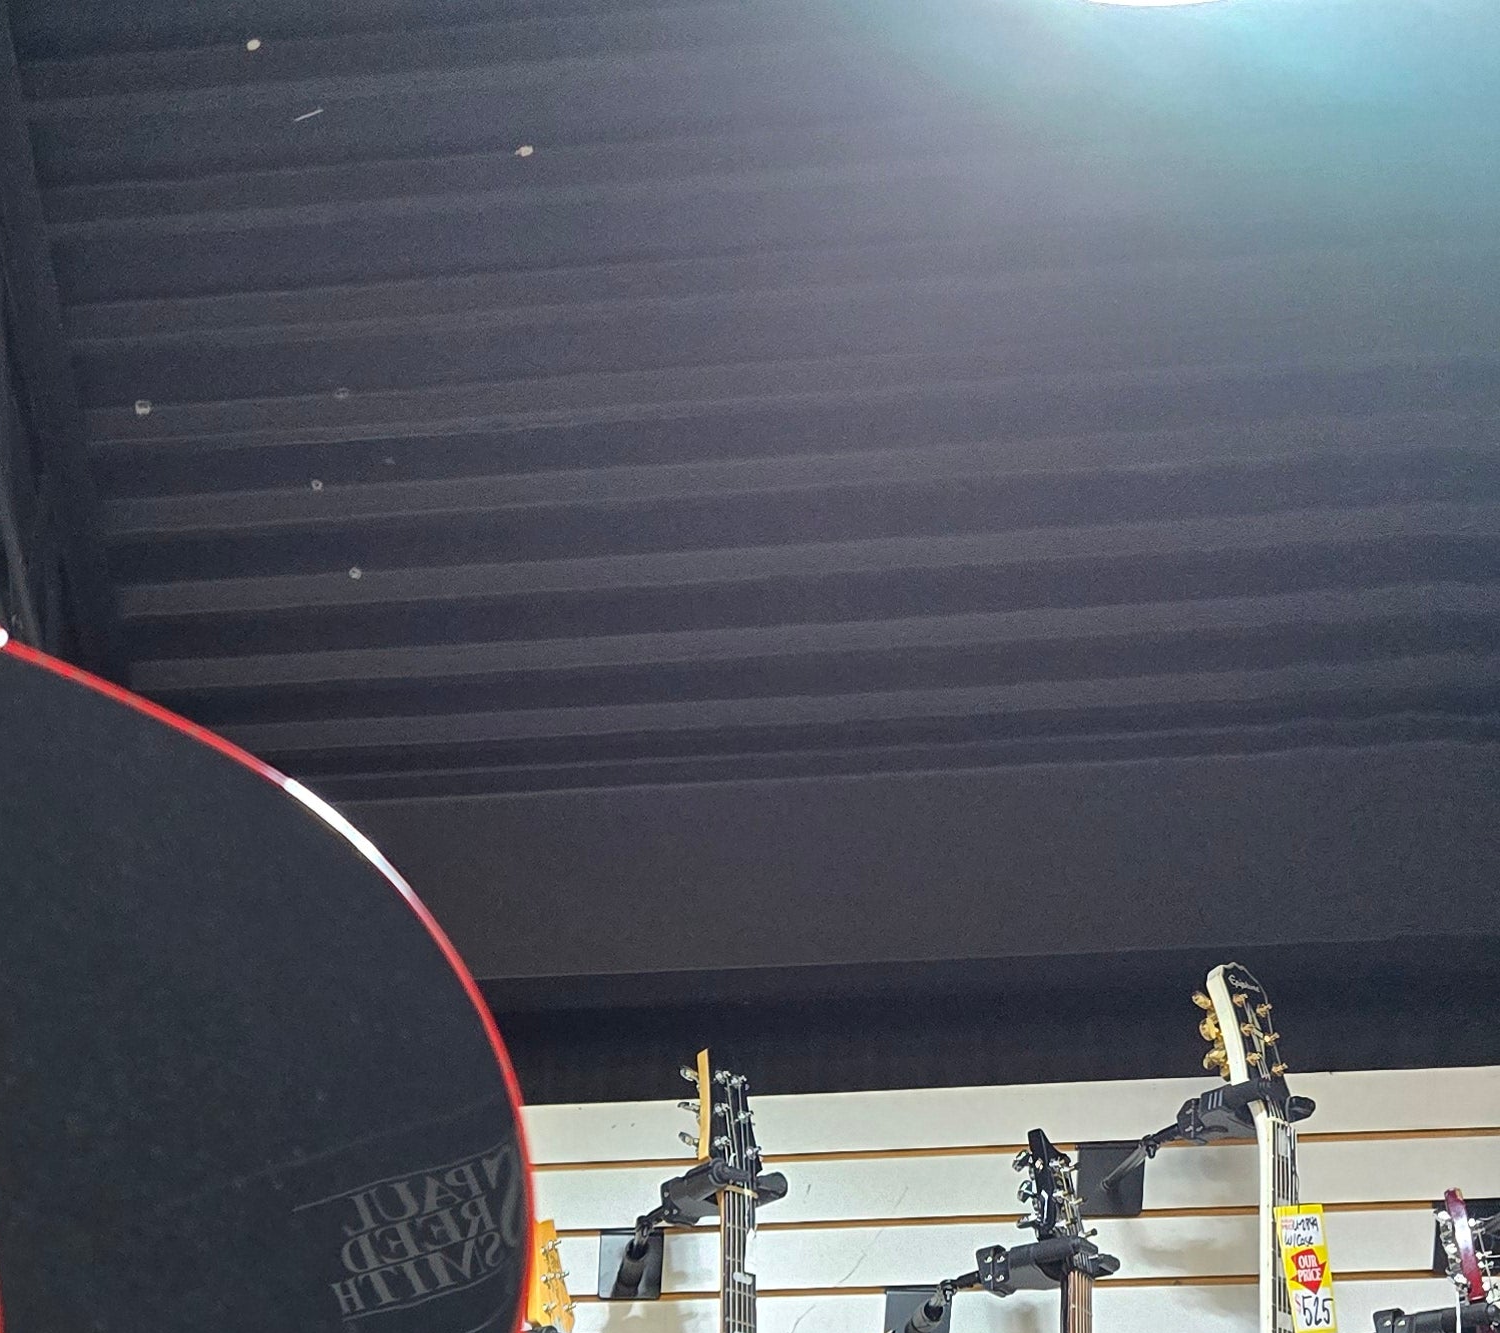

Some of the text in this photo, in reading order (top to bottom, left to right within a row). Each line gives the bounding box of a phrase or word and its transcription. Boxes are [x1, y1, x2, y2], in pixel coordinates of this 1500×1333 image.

[1298, 1255, 1318, 1268] OUR
[1297, 1268, 1322, 1282] PRICE
[1295, 1294, 1333, 1326] $525
